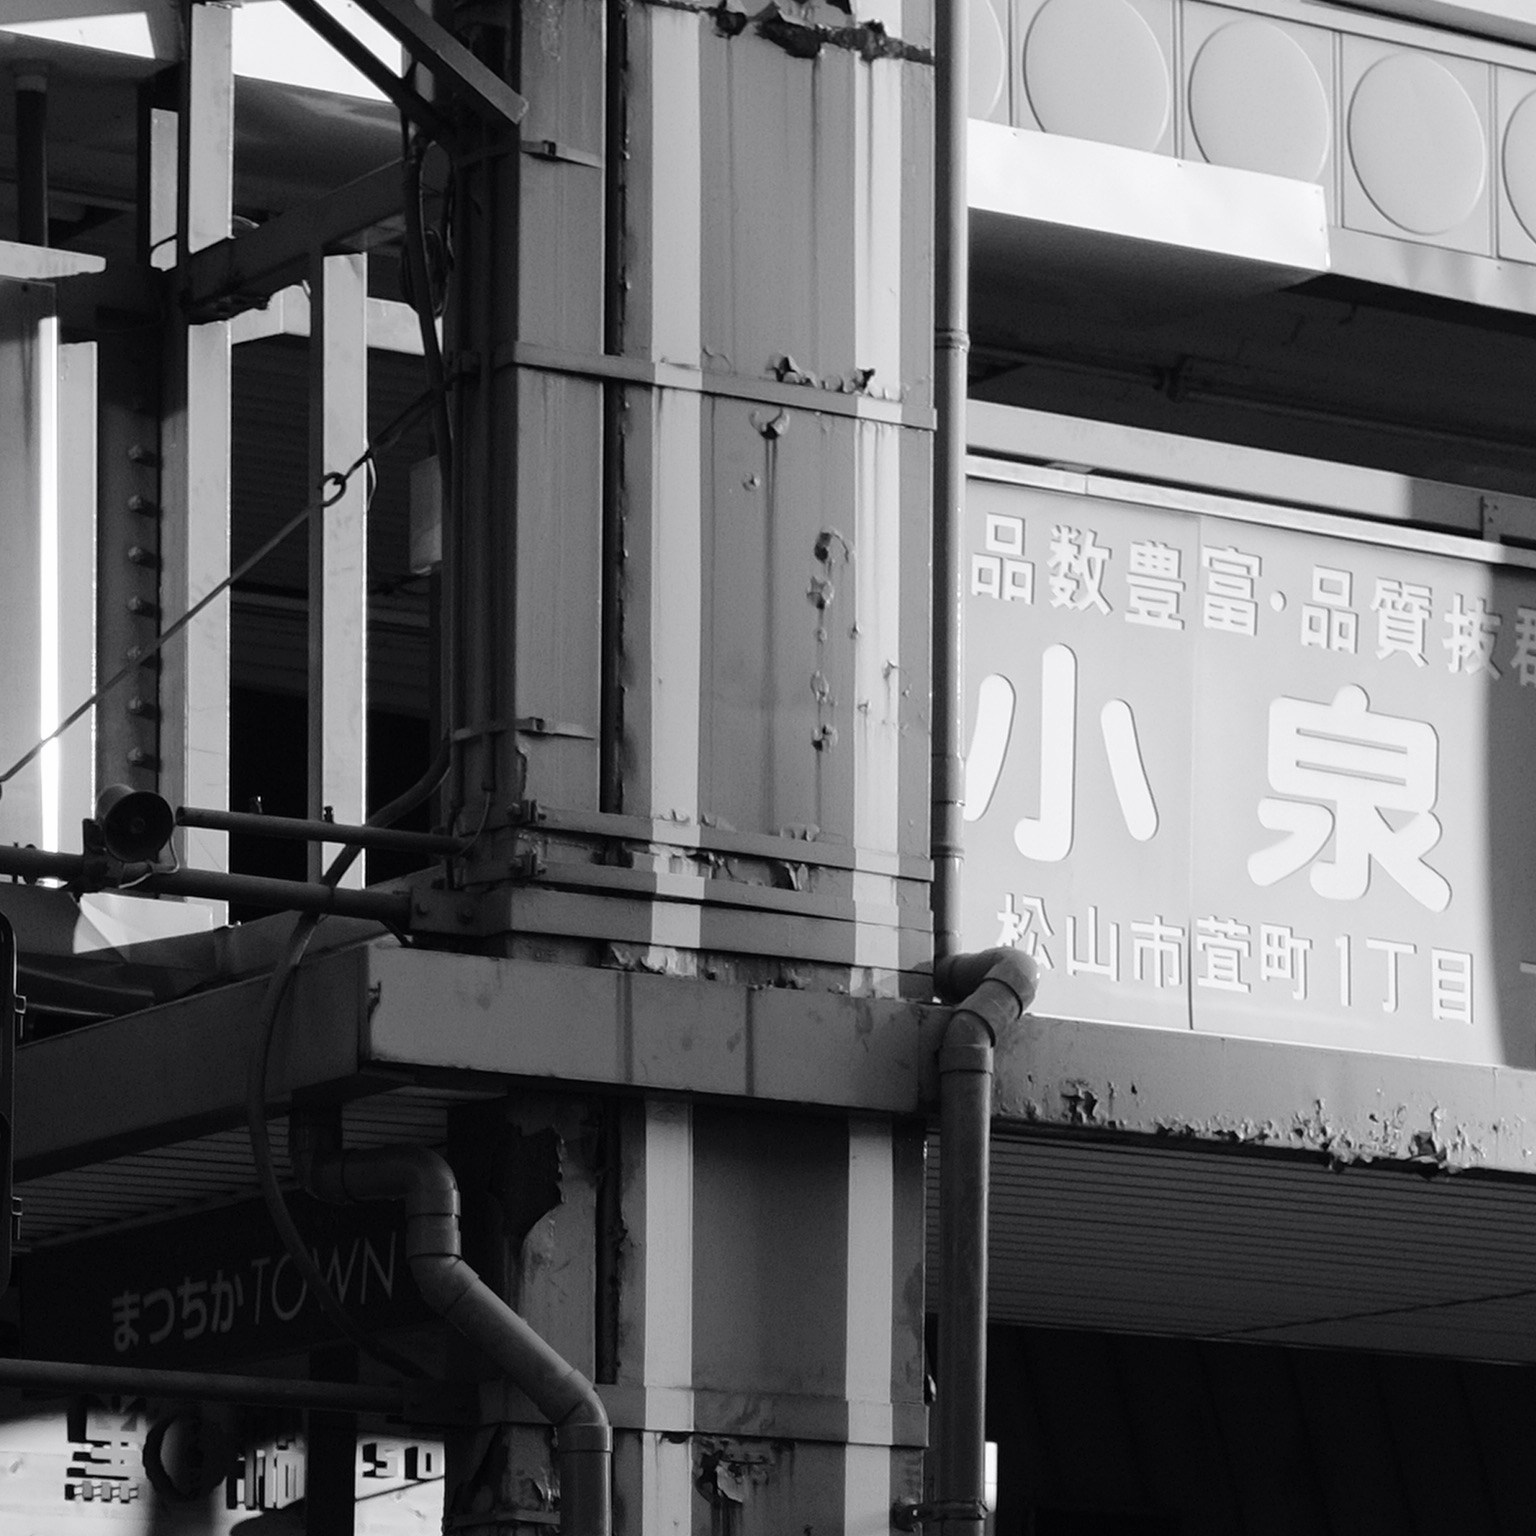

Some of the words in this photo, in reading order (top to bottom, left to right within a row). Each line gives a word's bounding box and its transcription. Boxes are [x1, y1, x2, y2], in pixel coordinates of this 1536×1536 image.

[963, 643, 1453, 913] 小泉
[996, 893, 1475, 1026] 松山市萱町1丁目
